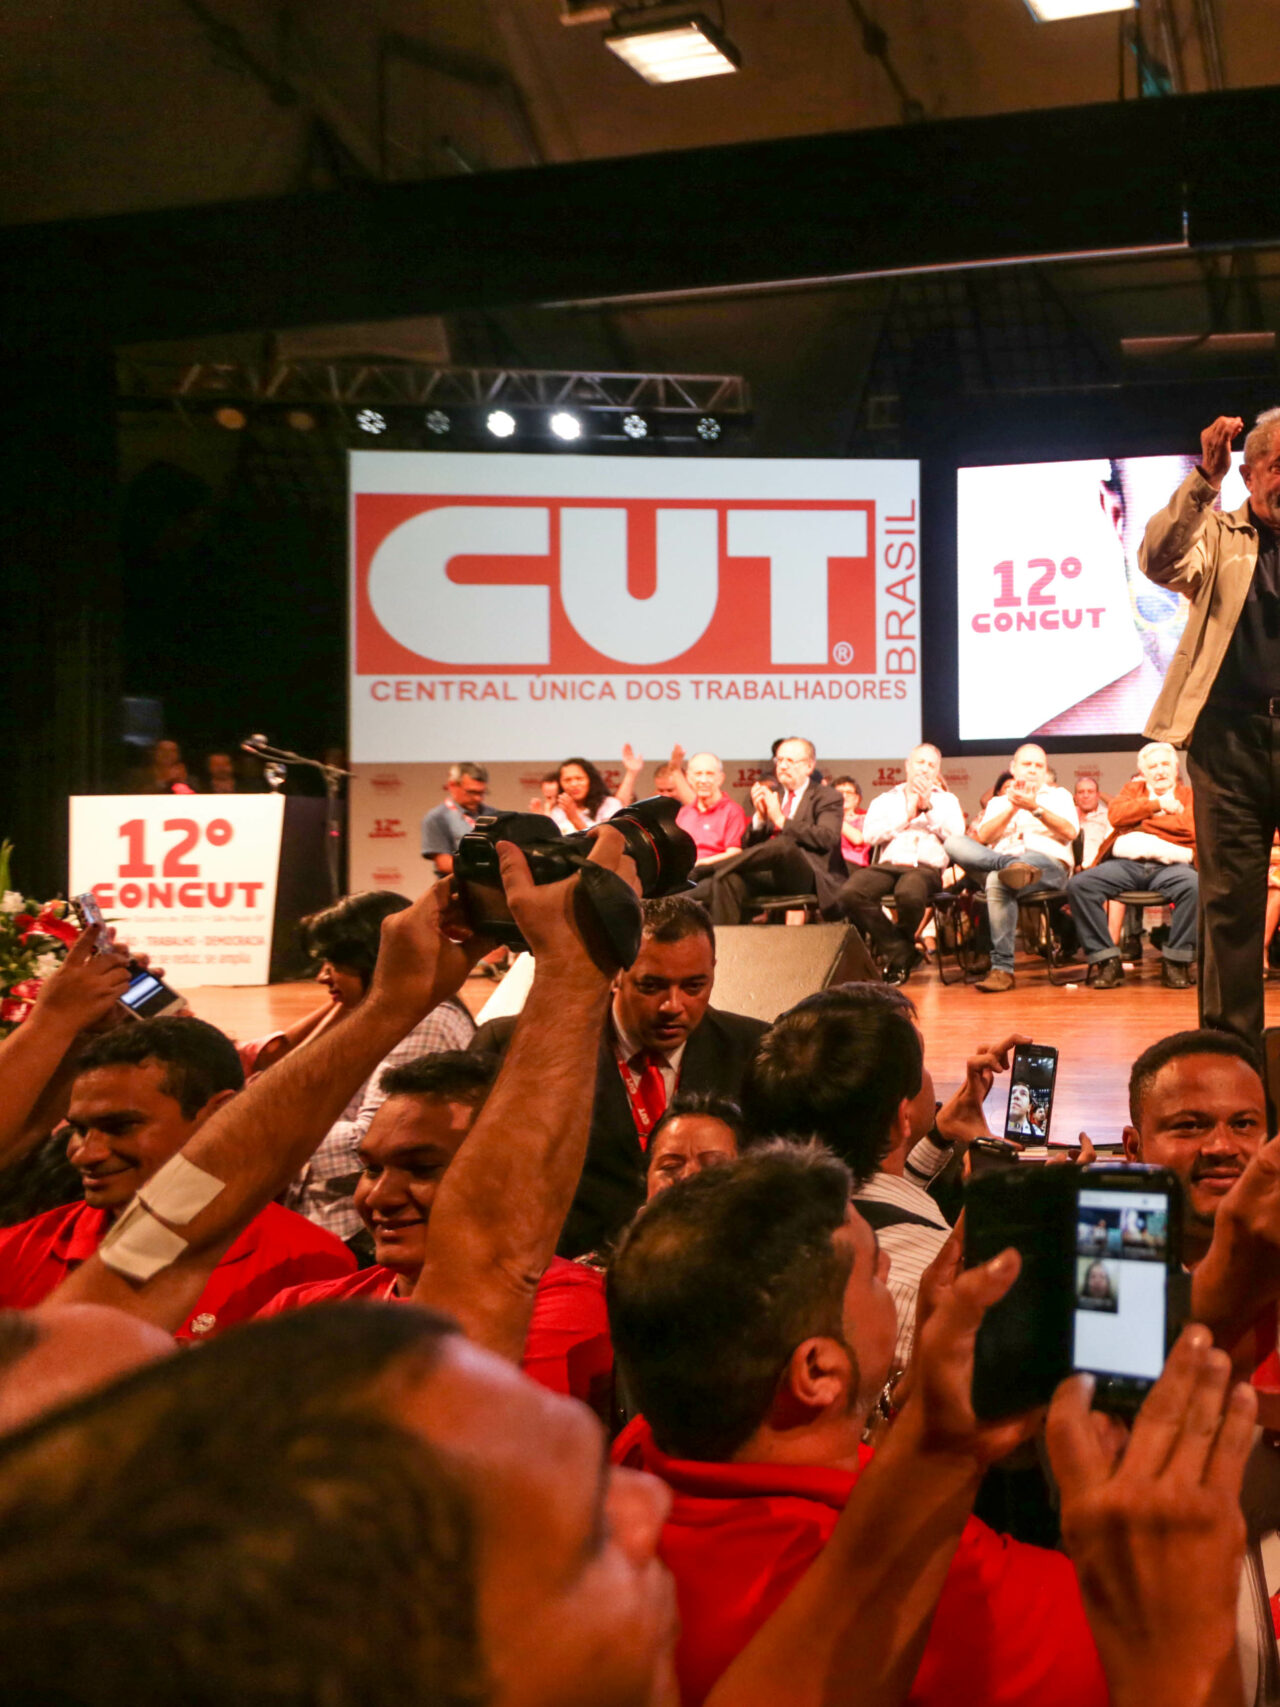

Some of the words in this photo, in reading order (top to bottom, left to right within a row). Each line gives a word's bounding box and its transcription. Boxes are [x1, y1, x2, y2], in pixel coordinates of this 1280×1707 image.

[367, 506, 867, 665] CUT
[885, 499, 916, 675] BRASIL
[971, 608, 1106, 633] CONCUT
[371, 680, 517, 702] CENTRAL
[529, 674, 616, 701] ÚNICA
[626, 680, 681, 700] DOS
[690, 680, 907, 701] TRABALHADORES
[90, 882, 264, 909] CONCUT
[626, 1078, 637, 1094] CUT
[638, 1108, 650, 1125] CUT
